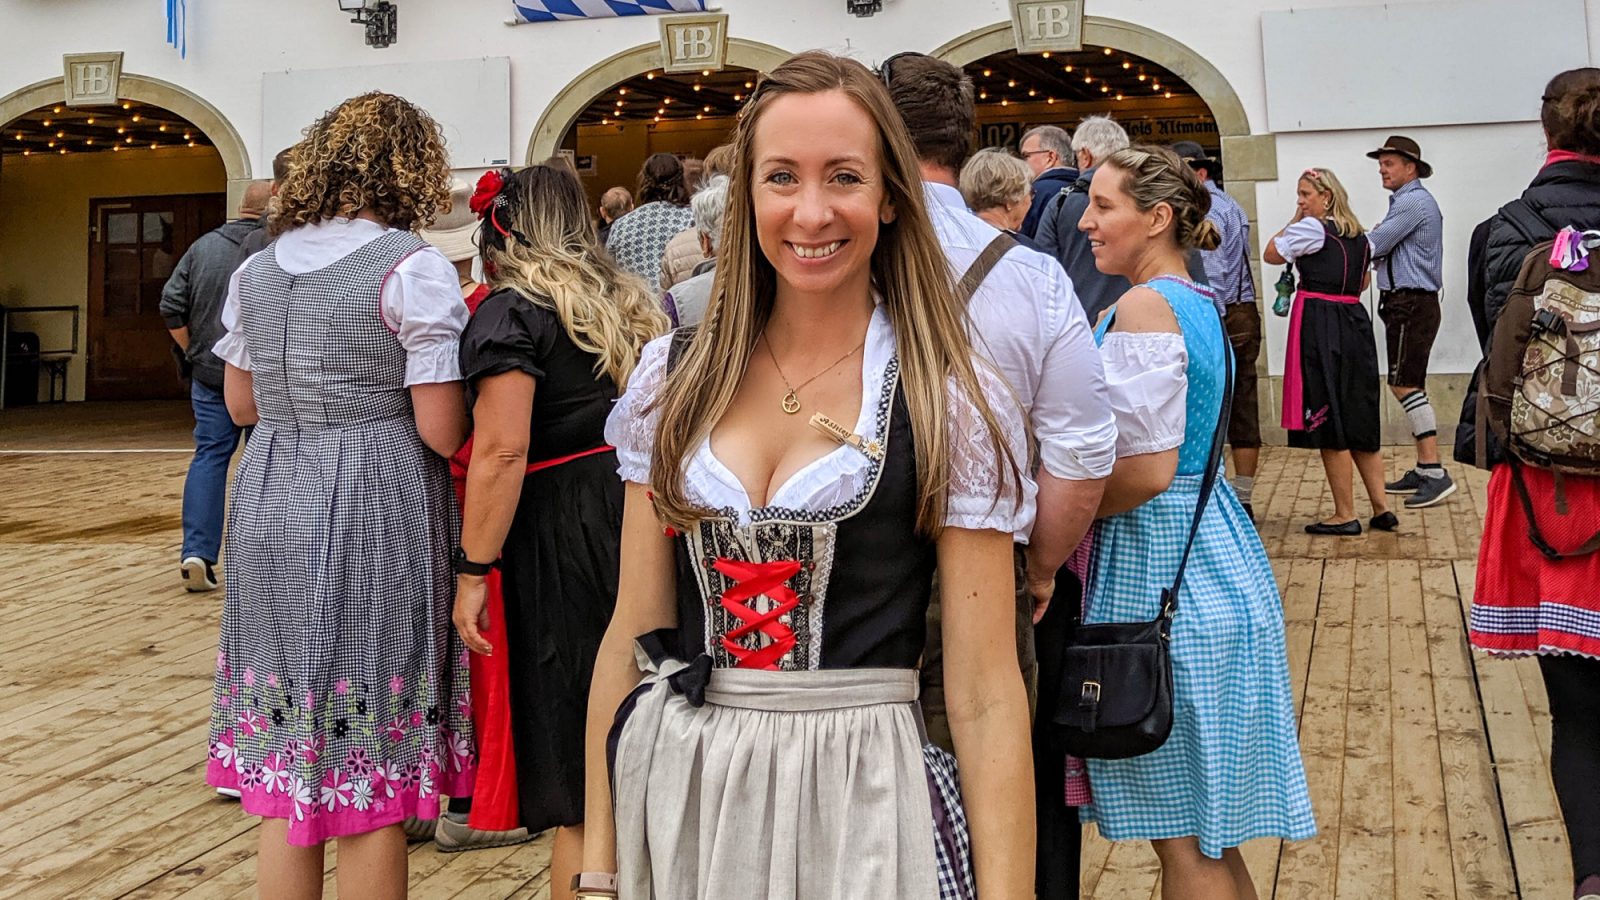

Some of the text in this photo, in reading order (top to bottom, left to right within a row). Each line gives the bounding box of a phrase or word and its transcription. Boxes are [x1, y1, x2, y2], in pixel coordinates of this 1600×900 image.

[1026, 4, 1070, 40] HB
[674, 26, 713, 60] HB
[75, 63, 110, 95] HB
